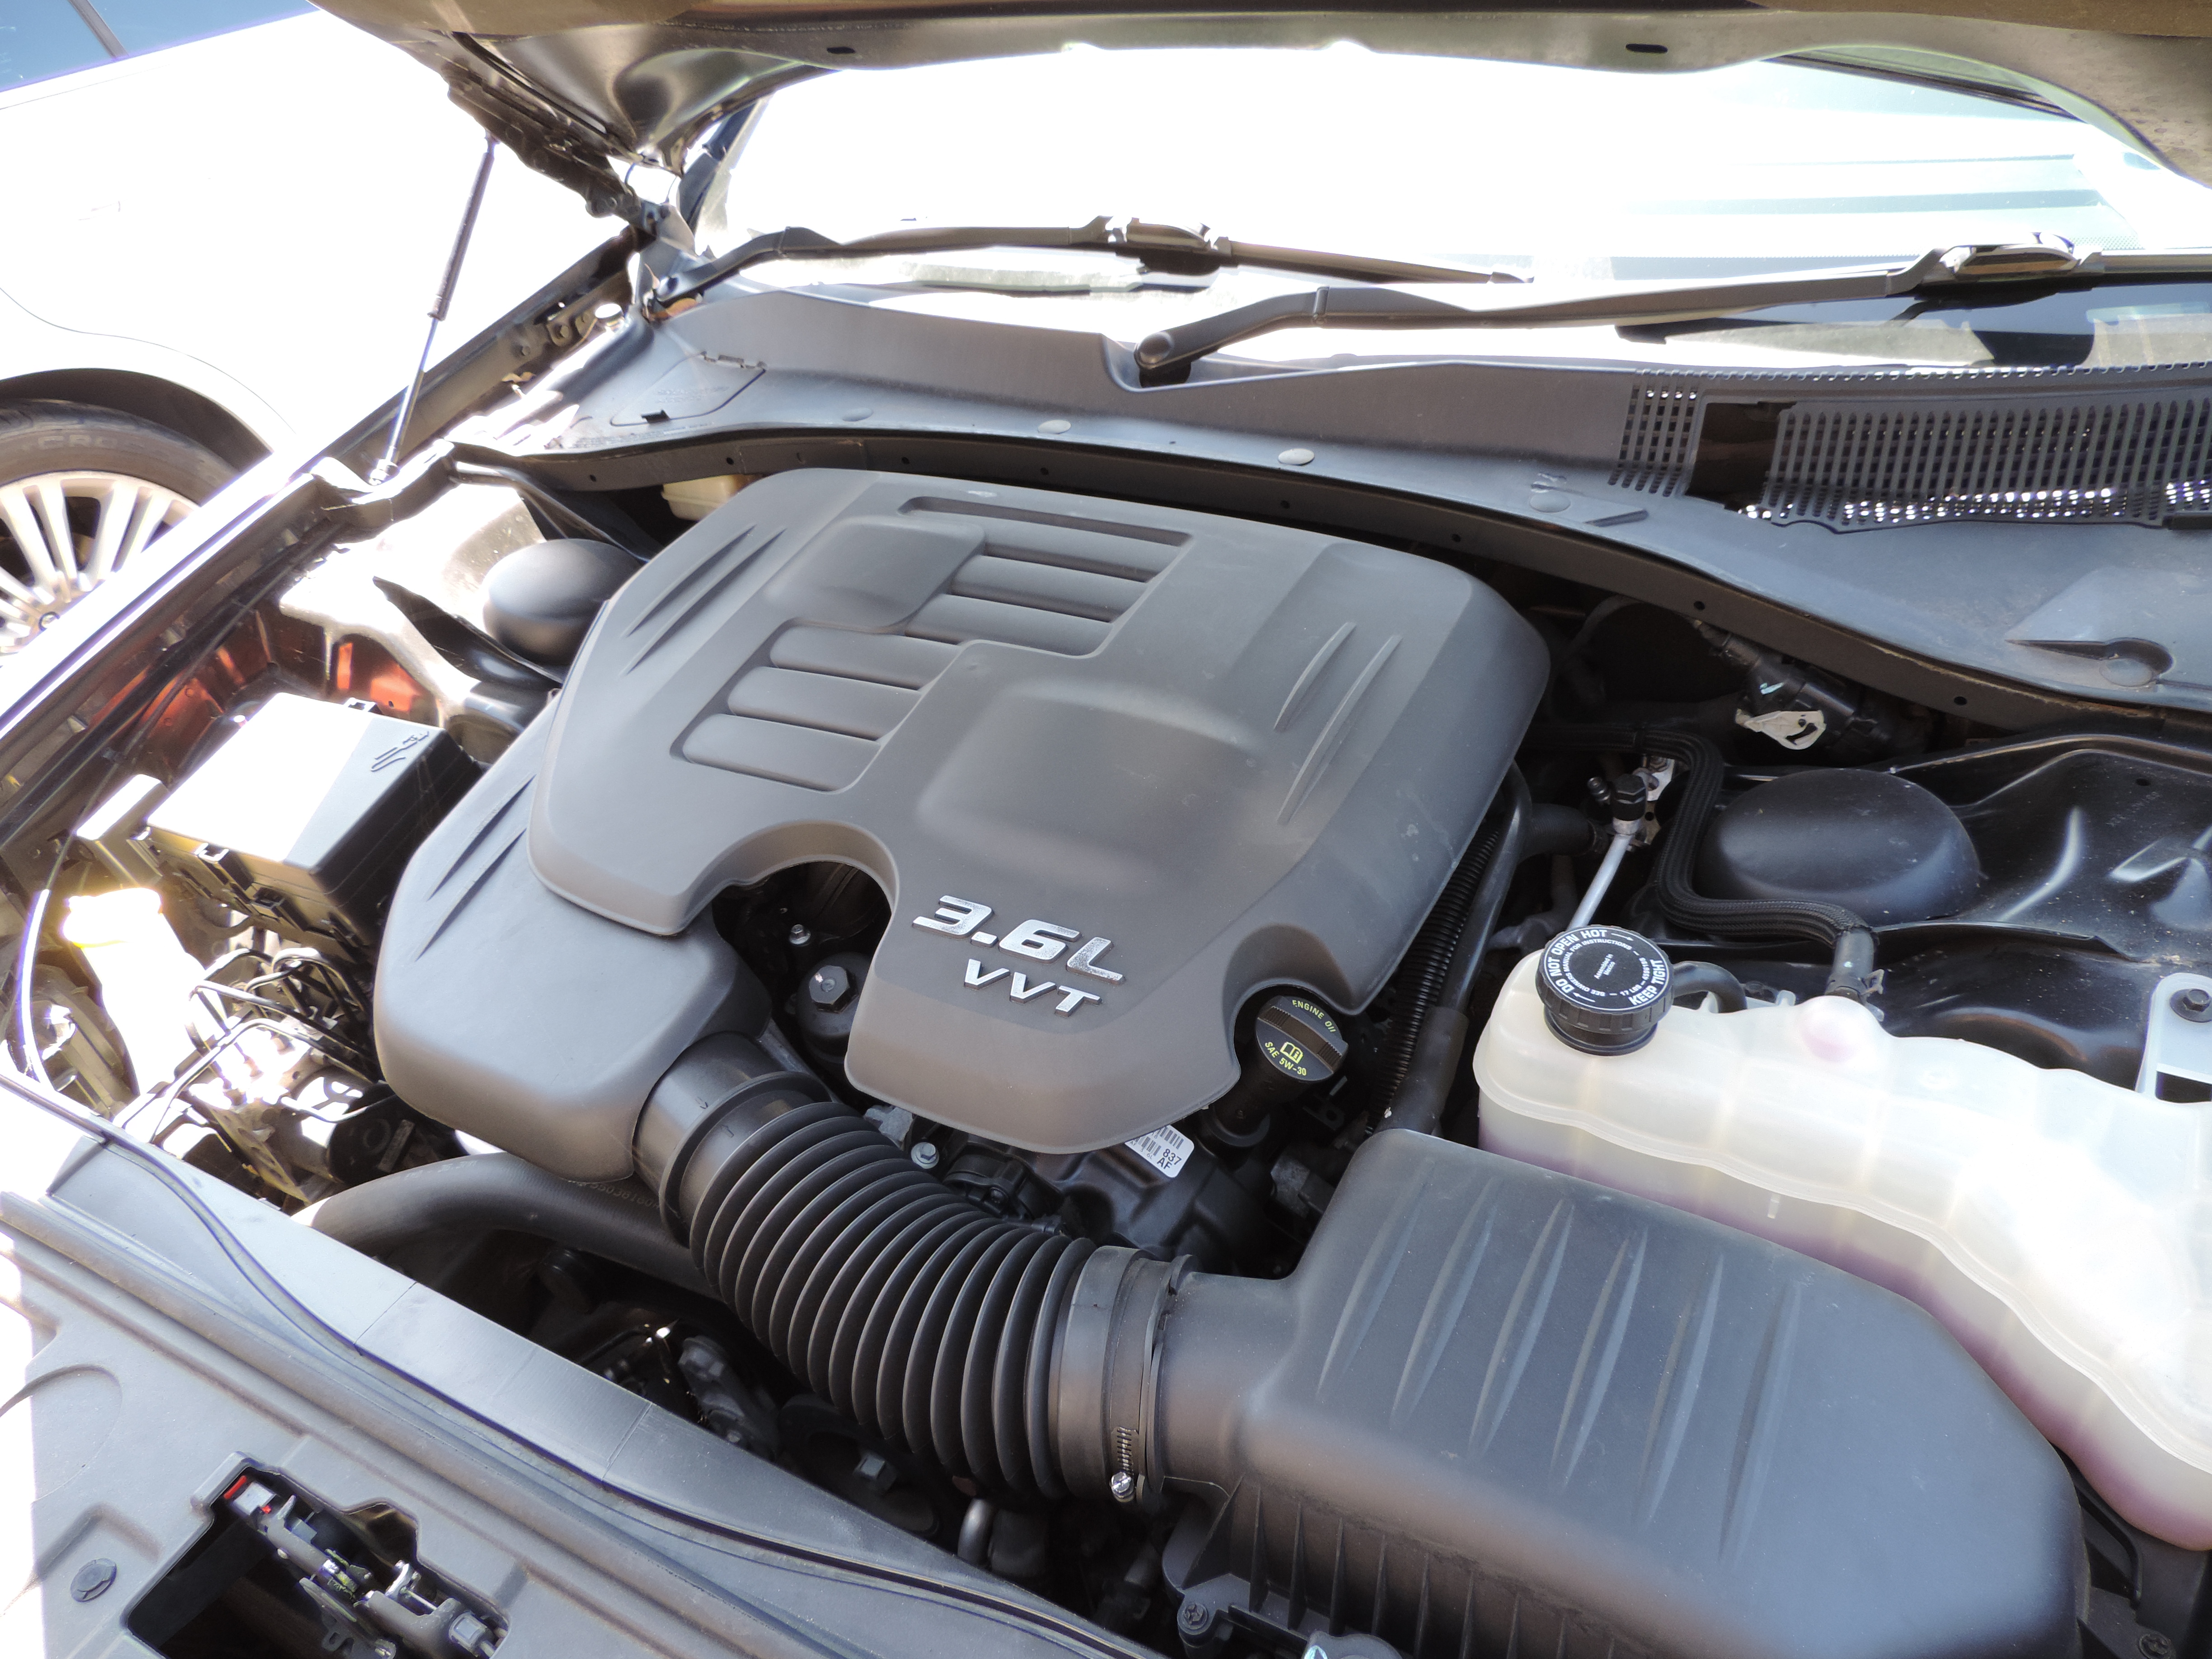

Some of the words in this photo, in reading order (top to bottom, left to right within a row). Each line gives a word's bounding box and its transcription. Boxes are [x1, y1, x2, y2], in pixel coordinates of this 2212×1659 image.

[912, 895, 1126, 986] 3.6L
[1580, 929, 1607, 938] HOT
[1551, 934, 1579, 956] OPEN
[1570, 943, 1583, 952] FOR
[1581, 938, 1632, 950] INSTRUCTIONS
[1548, 957, 1562, 977] NOT
[1563, 951, 1574, 972] MANUAL
[964, 958, 1102, 1017] VVT
[1556, 979, 1575, 993] DO
[1565, 972, 1590, 992] OWNERS
[1628, 985, 1658, 1005] KEEP
[1650, 959, 1666, 985] TIGHT
[1292, 1000, 1324, 1019] ENGINE
[1265, 1042, 1279, 1058] SAE
[1279, 1058, 1307, 1076] 5W-30
[1157, 1158, 1172, 1169] AF
[1163, 1148, 1182, 1165] 837
